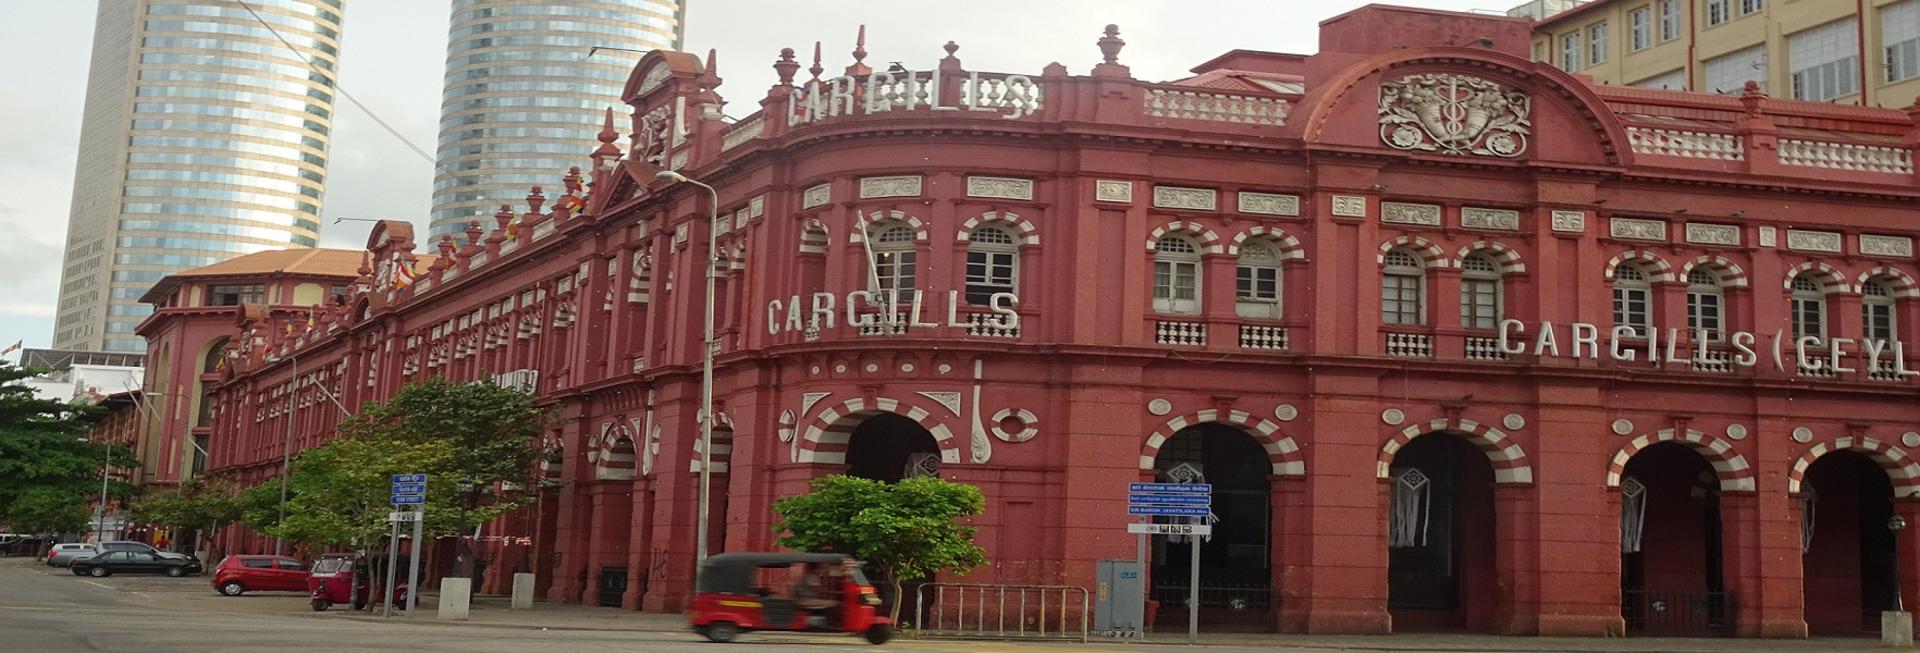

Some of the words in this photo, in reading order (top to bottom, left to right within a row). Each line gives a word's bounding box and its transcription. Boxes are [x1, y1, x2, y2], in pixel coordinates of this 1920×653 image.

[788, 70, 1034, 126] CARGILLS
[768, 290, 1018, 335] CARGILLS
[1499, 319, 1757, 366] CARGILLS
[1772, 328, 1920, 375] (CEYL
